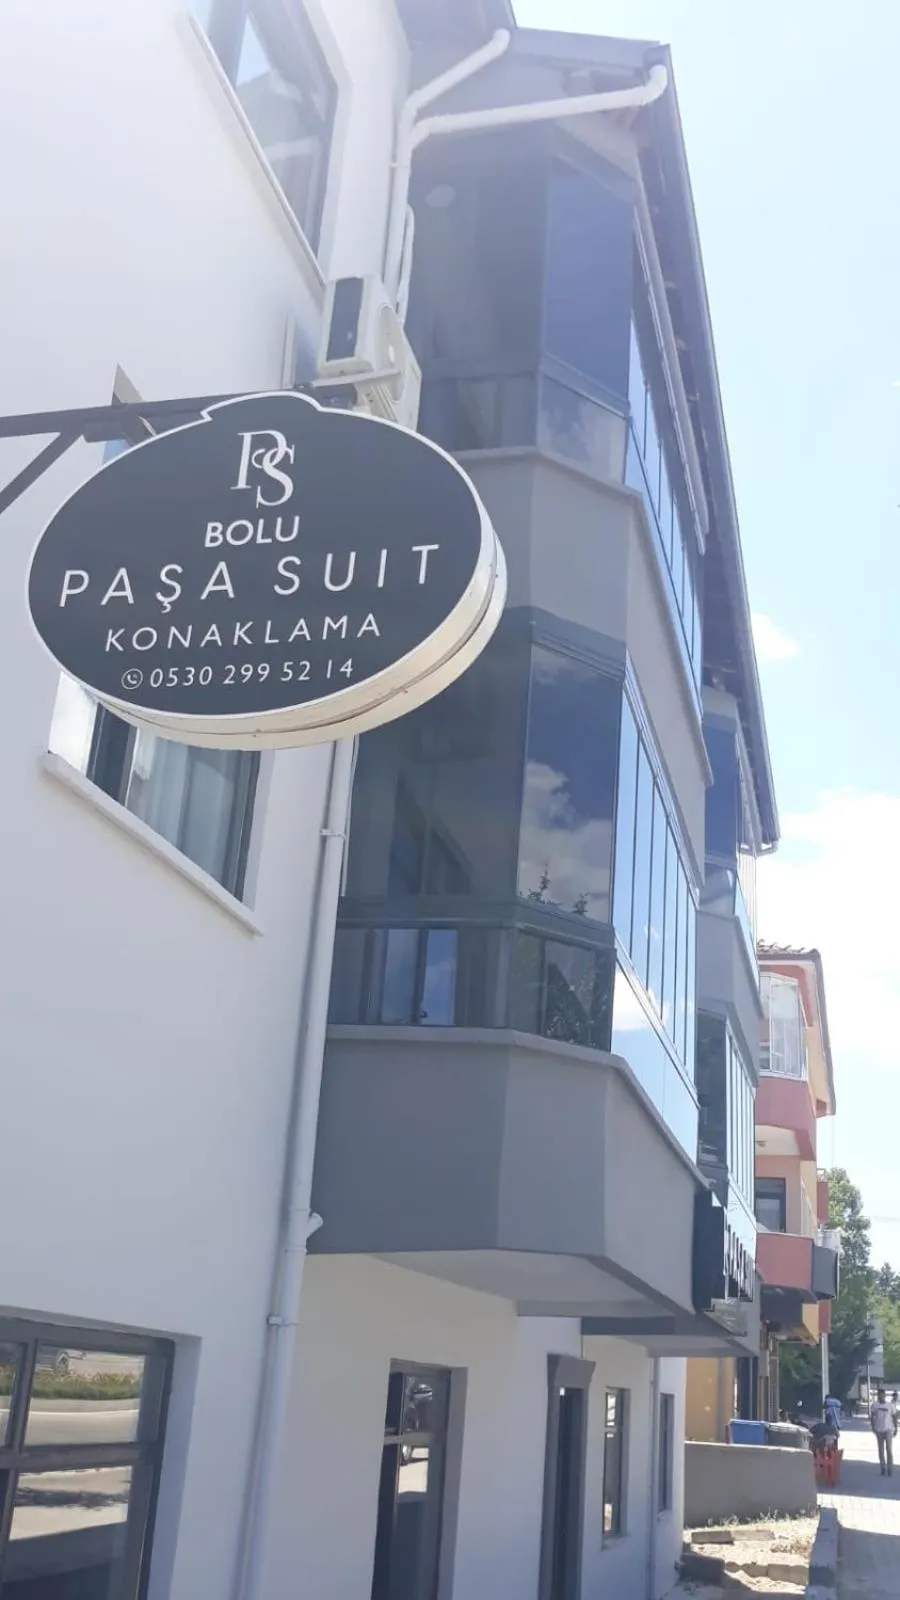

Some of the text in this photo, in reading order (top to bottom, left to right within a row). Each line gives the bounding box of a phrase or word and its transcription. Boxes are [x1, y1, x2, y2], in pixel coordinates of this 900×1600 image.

[204, 515, 300, 547] BOLU
[59, 544, 440, 613] PAŞA SUIT
[105, 613, 381, 653] KONAKLAMA
[149, 658, 354, 688] 0530 299 52 14
